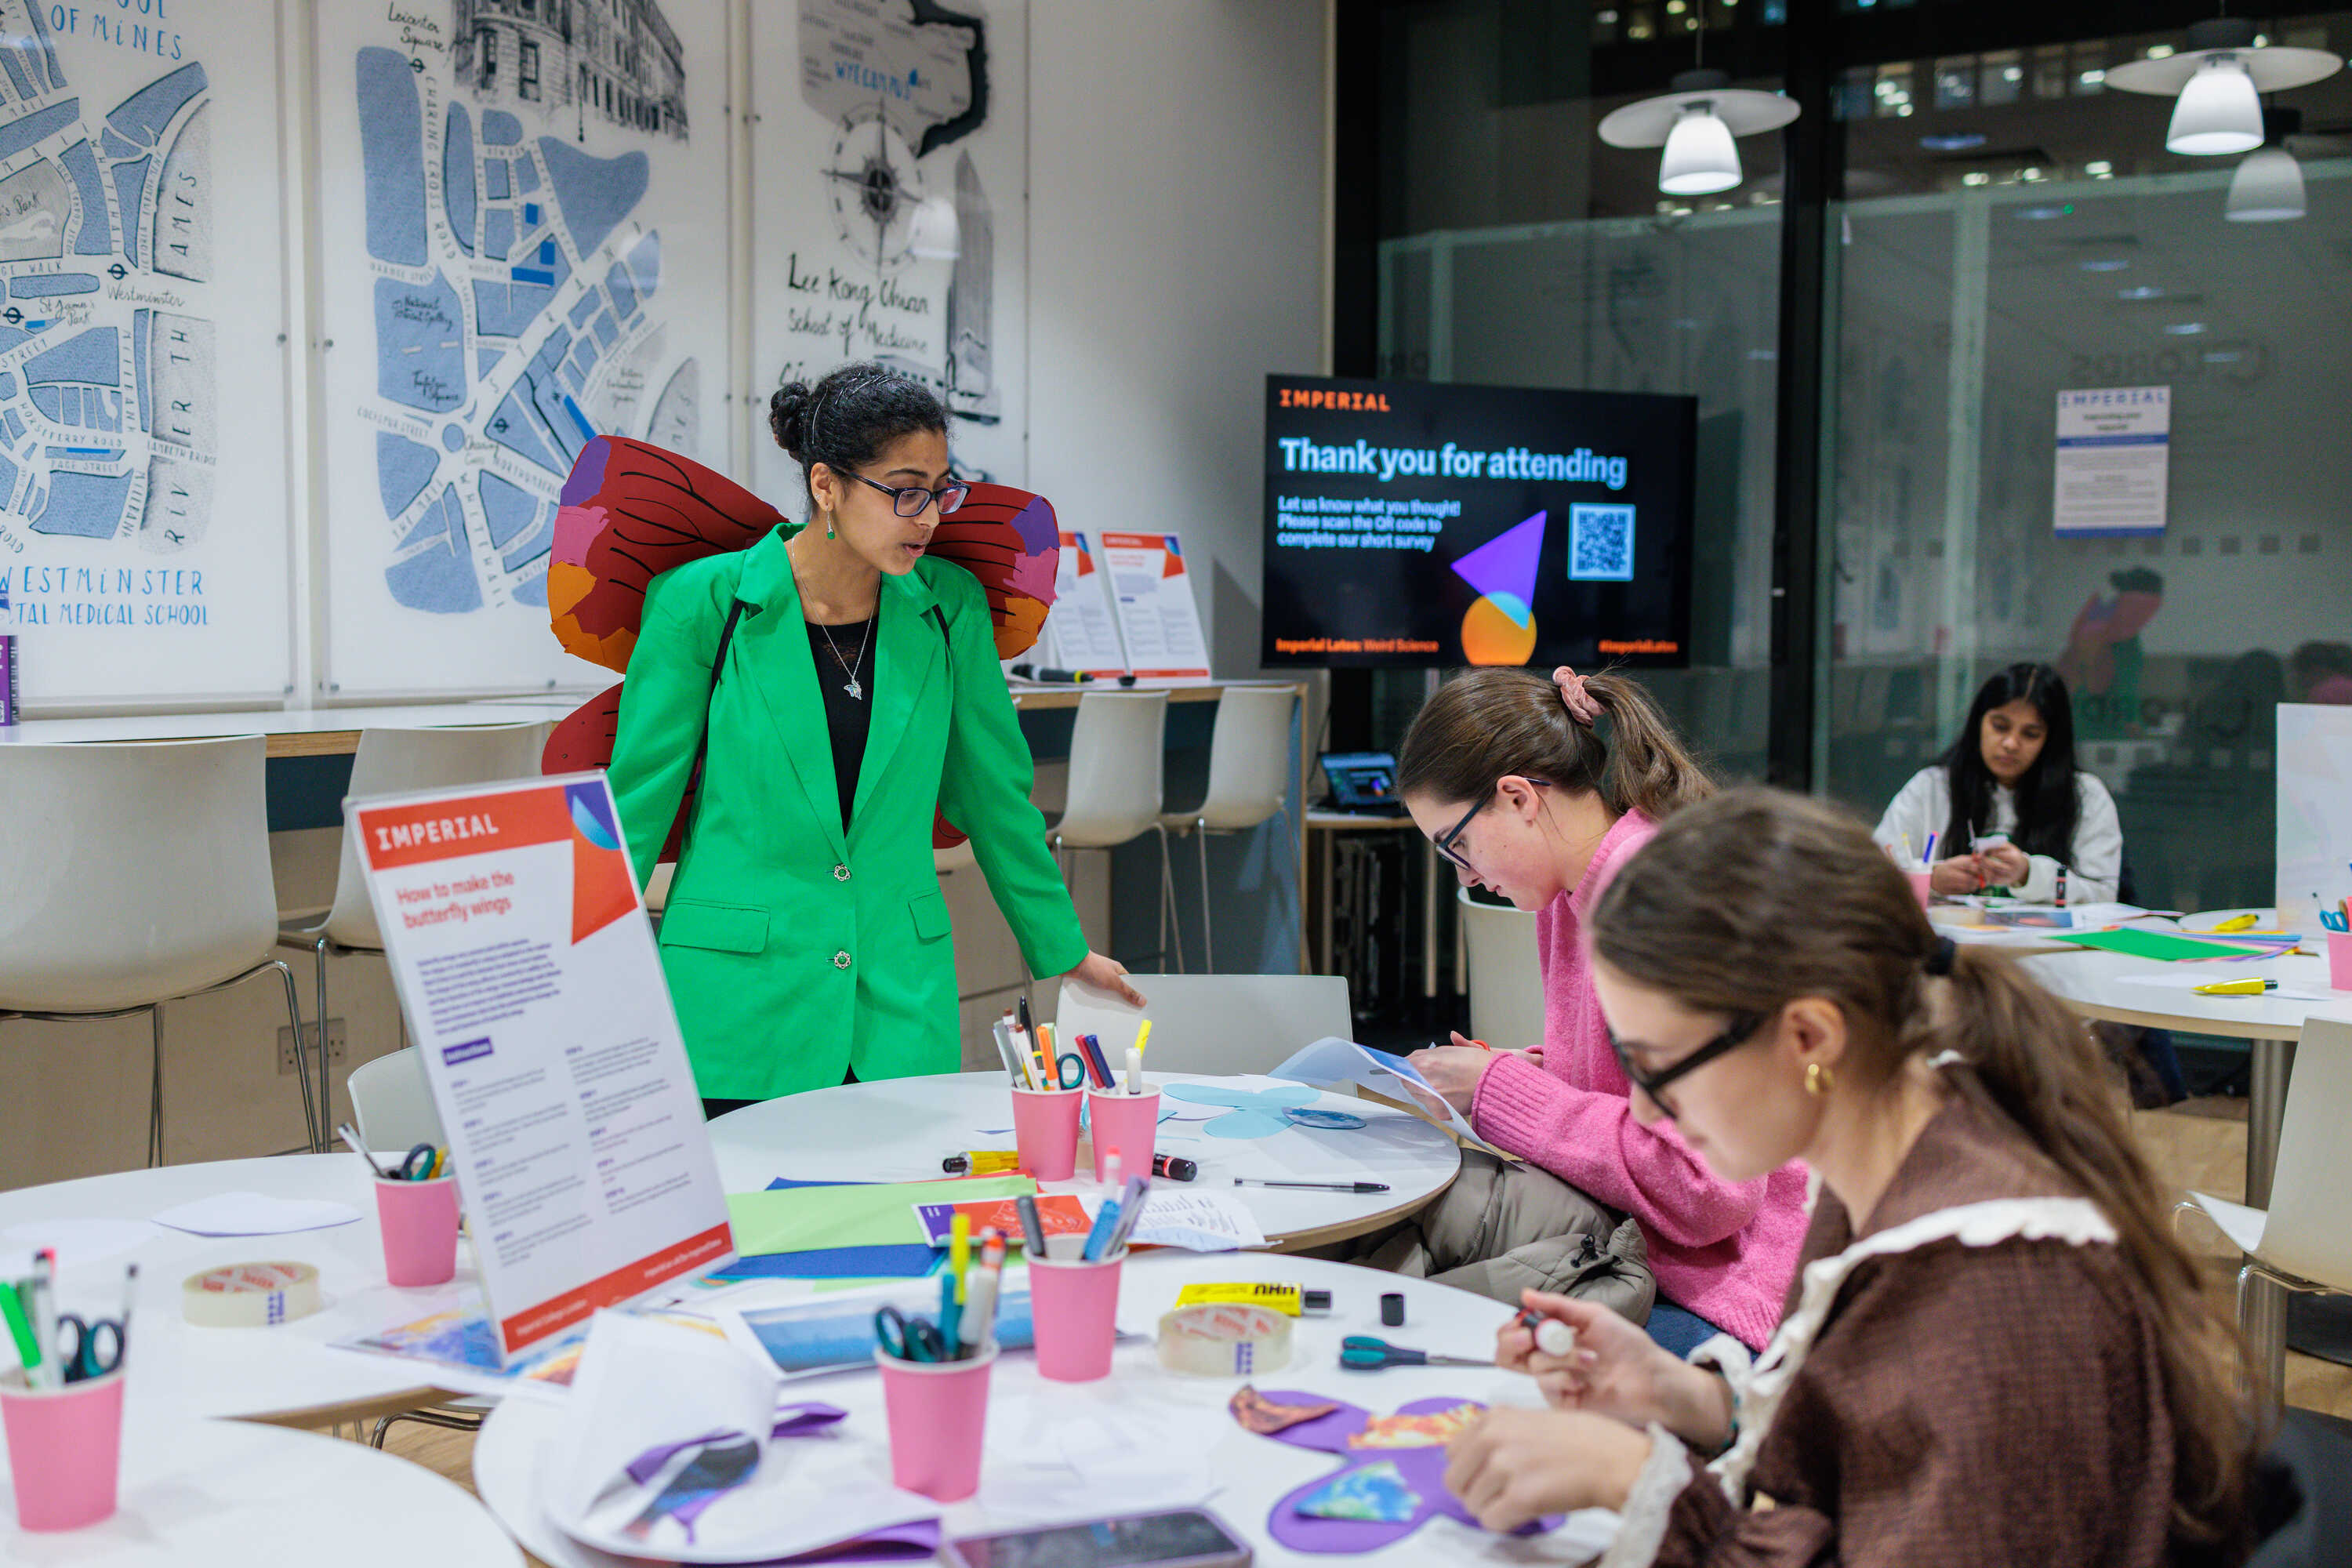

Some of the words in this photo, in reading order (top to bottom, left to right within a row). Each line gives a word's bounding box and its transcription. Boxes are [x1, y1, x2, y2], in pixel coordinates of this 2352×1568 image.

[51, 5, 80, 34] OF
[426, 76, 438, 151] CHARING
[428, 158, 441, 210] CROSS
[434, 220, 456, 260] ROAD
[29, 261, 62, 274] WALK
[107, 284, 185, 307] Westminster
[789, 252, 820, 293] Lee
[828, 267, 876, 328] Kong
[788, 307, 832, 335] School
[839, 315, 854, 356] of
[864, 320, 928, 354] Medicine
[1279, 389, 1391, 412] IMPERIAL
[1278, 437, 1377, 472] Thank
[1377, 445, 1436, 483] you
[1439, 442, 1486, 478] for
[1488, 448, 1628, 491] attending
[1277, 495, 1301, 512] Let
[1301, 499, 1318, 513] us
[1319, 496, 1353, 514] know
[1354, 498, 1385, 514] what
[1386, 501, 1409, 517] you
[1277, 514, 1319, 529] Please
[1321, 516, 1351, 530] scan
[1352, 514, 1374, 531] the
[1374, 516, 1395, 532] QR
[1396, 516, 1427, 533] code
[1428, 518, 1443, 533] to
[1277, 531, 1337, 550] complete
[1338, 533, 1359, 548] our
[1360, 532, 1393, 548] short
[143, 603, 208, 626] SCHOOL
[1276, 637, 1325, 655] Imperial
[376, 813, 499, 852] IMPERIAL
[396, 887, 432, 906] How
[433, 883, 450, 898] to
[452, 877, 488, 896] make
[491, 870, 514, 887] the
[403, 902, 469, 930] butterfly
[471, 896, 513, 919] wings
[1254, 1284, 1297, 1296] UHU
